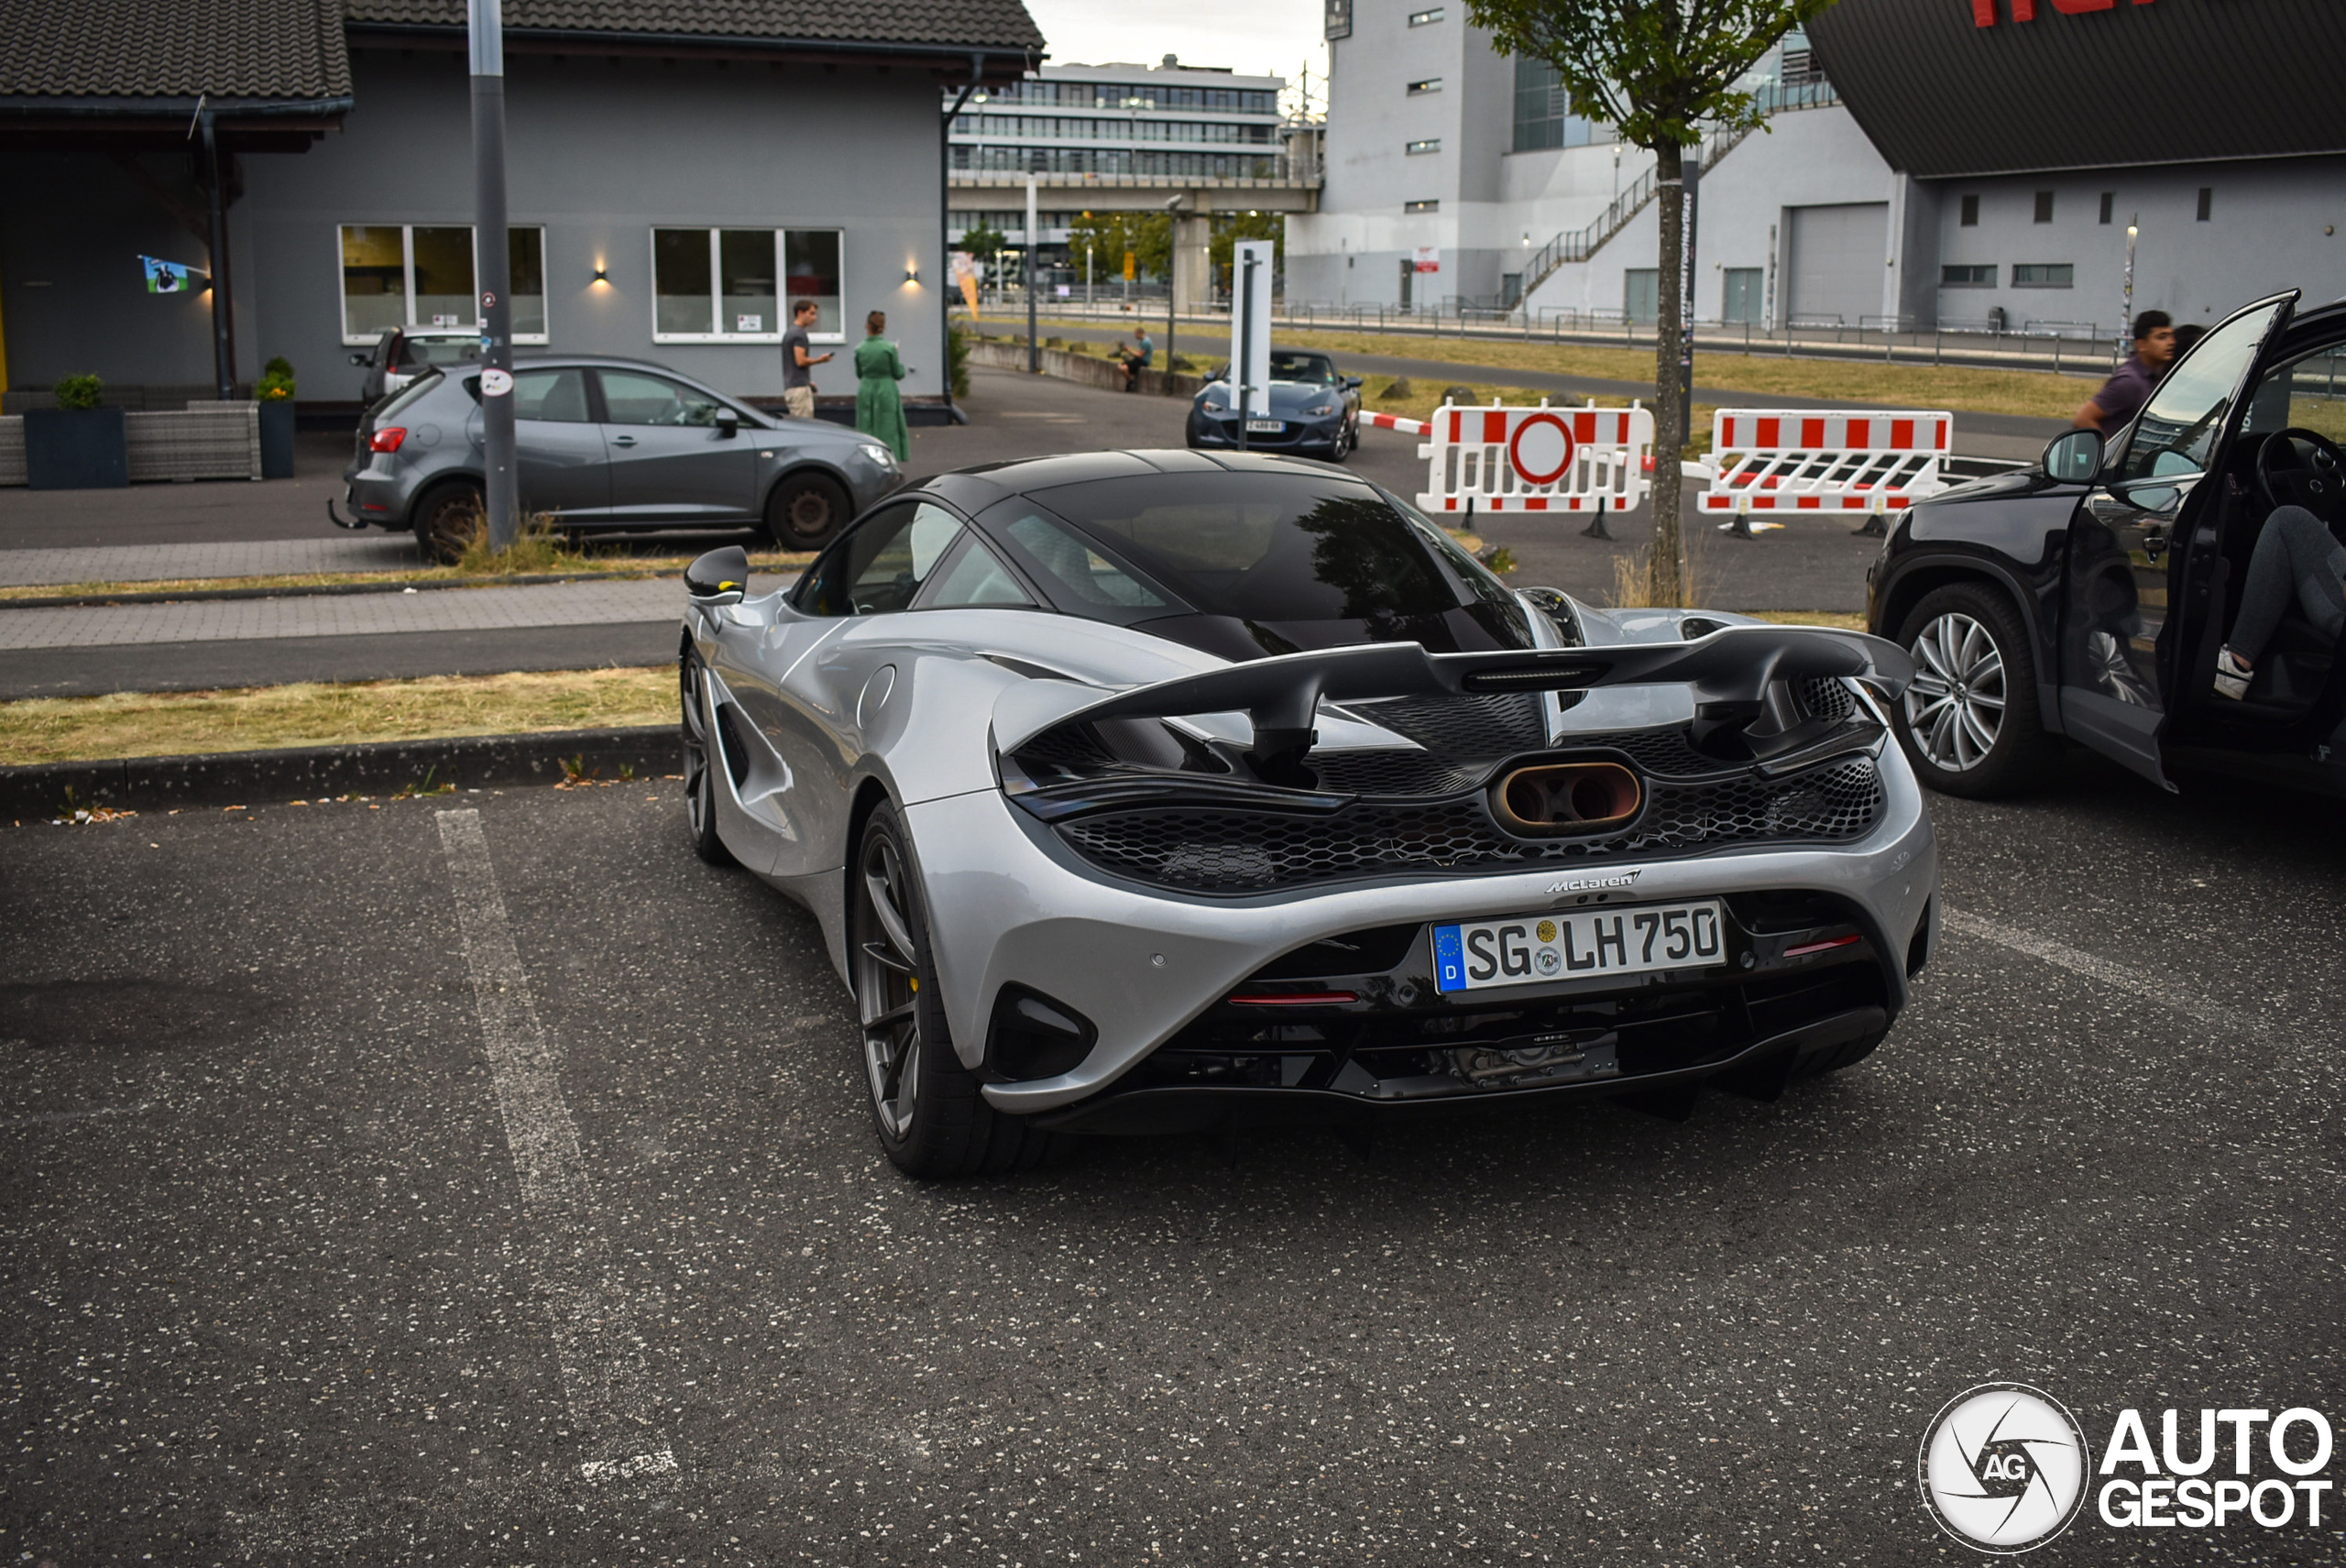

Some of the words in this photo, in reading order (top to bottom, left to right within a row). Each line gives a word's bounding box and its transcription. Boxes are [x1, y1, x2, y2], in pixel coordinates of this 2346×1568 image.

[1544, 874, 1634, 894] McLaren
[1467, 926, 1532, 981] SG
[1562, 916, 1627, 970] LH
[1633, 907, 1718, 962] 750
[1445, 965, 1457, 980] D
